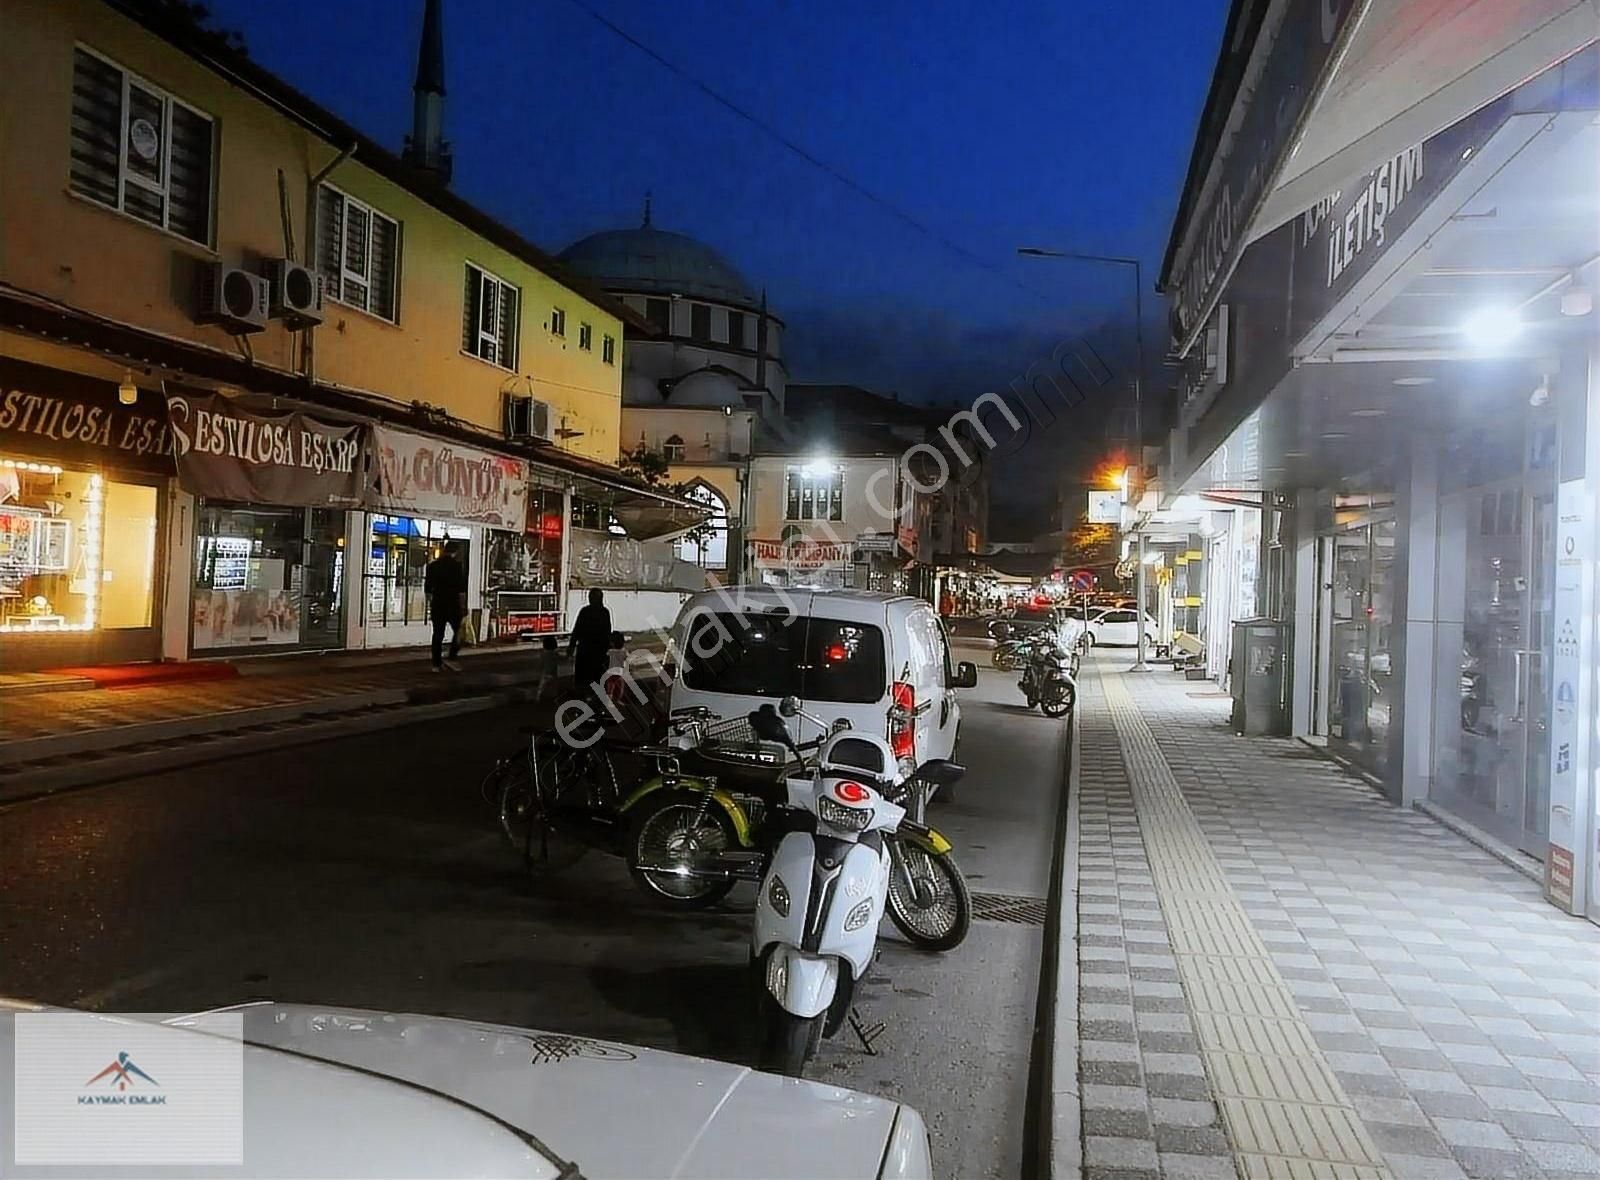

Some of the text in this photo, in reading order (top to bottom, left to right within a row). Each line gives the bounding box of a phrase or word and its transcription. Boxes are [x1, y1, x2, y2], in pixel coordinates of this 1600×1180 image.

[0, 388, 112, 446] STILOSA
[195, 409, 295, 467] ESTILOSA
[300, 429, 357, 475] EŞARP
